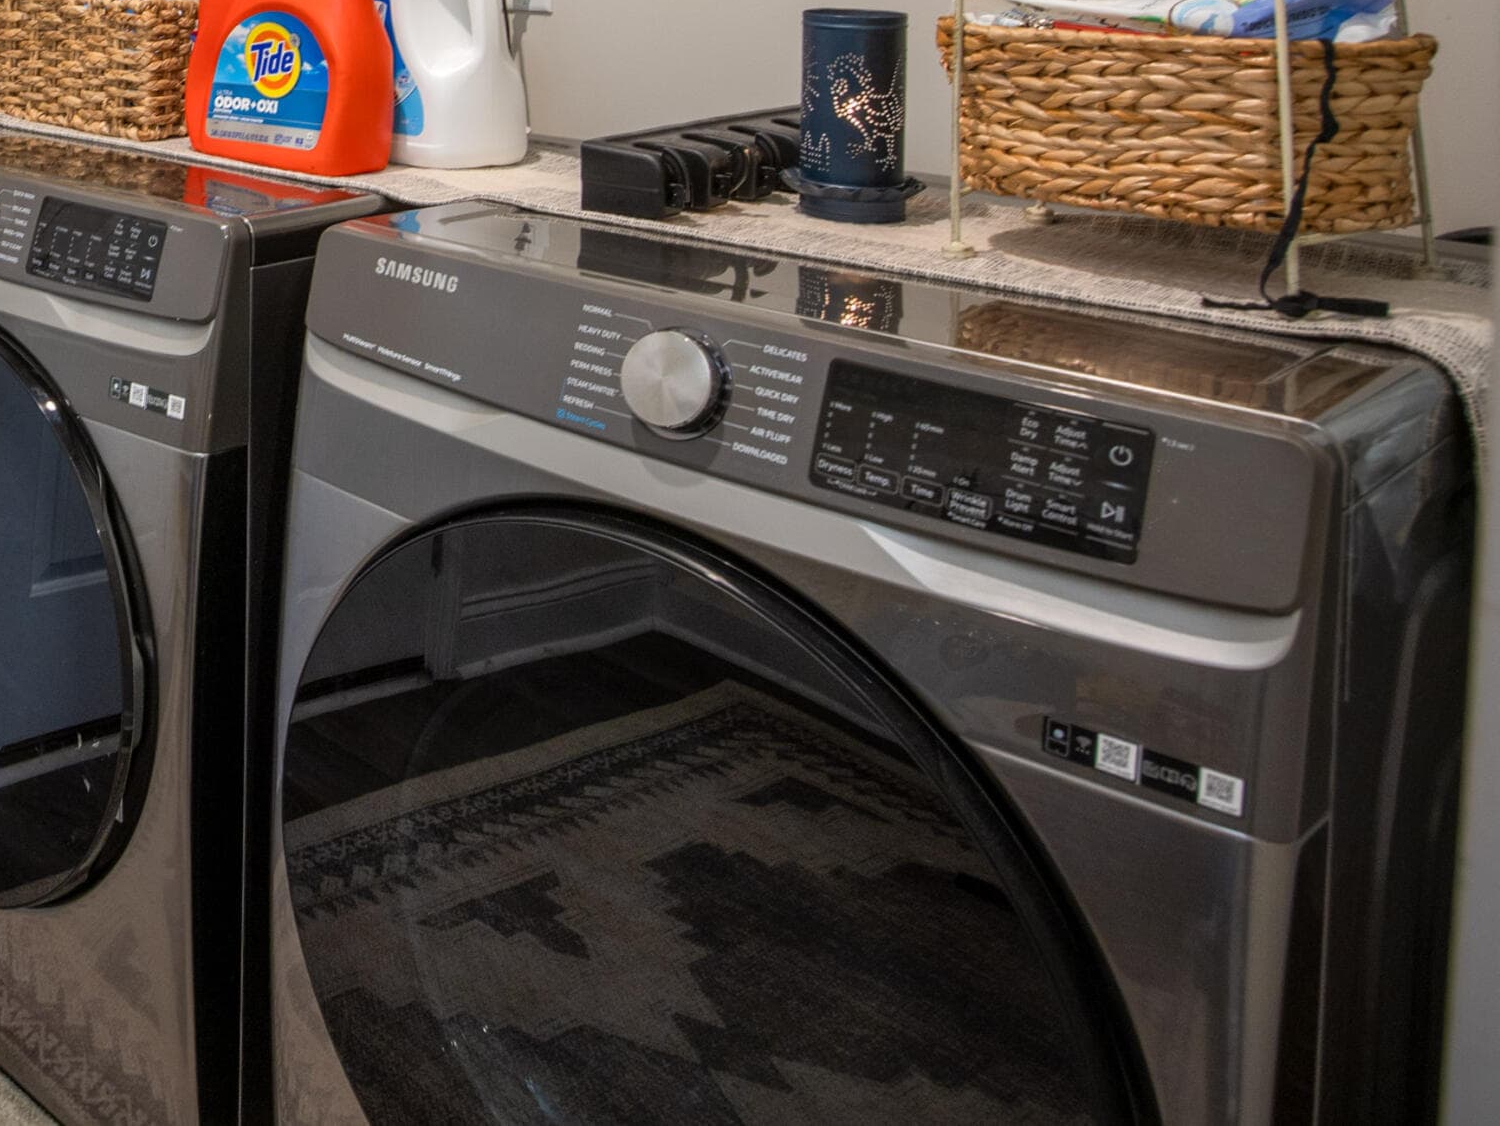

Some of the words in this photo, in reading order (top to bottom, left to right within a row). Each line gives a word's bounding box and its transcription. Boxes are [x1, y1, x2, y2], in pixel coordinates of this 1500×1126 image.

[250, 40, 295, 82] Tide
[375, 257, 459, 293] SAMSUNG
[582, 304, 612, 317] NORMAL
[578, 324, 601, 335] HEAVY
[601, 330, 621, 340] DUTY
[574, 341, 605, 356] BEDDING
[763, 344, 808, 362] DELICATES
[570, 359, 590, 370] PERM
[590, 364, 613, 377] PRESS
[749, 364, 803, 385] ACTIVEWEAR
[562, 394, 594, 409] REFRESH
[754, 386, 780, 400] QUICK
[780, 393, 799, 404] DRY
[757, 406, 777, 420] TIME
[777, 413, 795, 424] DRY
[1021, 416, 1039, 429] Eco
[750, 426, 765, 438] AIR
[765, 430, 792, 444] FLUFF
[1020, 427, 1038, 440] Dry
[1054, 425, 1087, 440] Adjust
[1054, 434, 1078, 448] Time
[732, 441, 788, 465] DOWNLOADED
[1010, 451, 1039, 467] Damp
[818, 458, 853, 476] Dryness
[1010, 463, 1035, 476] Alert
[1048, 461, 1081, 476] Adjust
[1048, 471, 1073, 485] Time
[910, 483, 934, 499] Time
[1005, 487, 1032, 503] Drum
[951, 491, 987, 508] Wrinkle
[1005, 498, 1030, 514] Light
[1045, 498, 1077, 515] Smart
[949, 499, 987, 519] Prevent
[1041, 509, 1079, 526] Control
